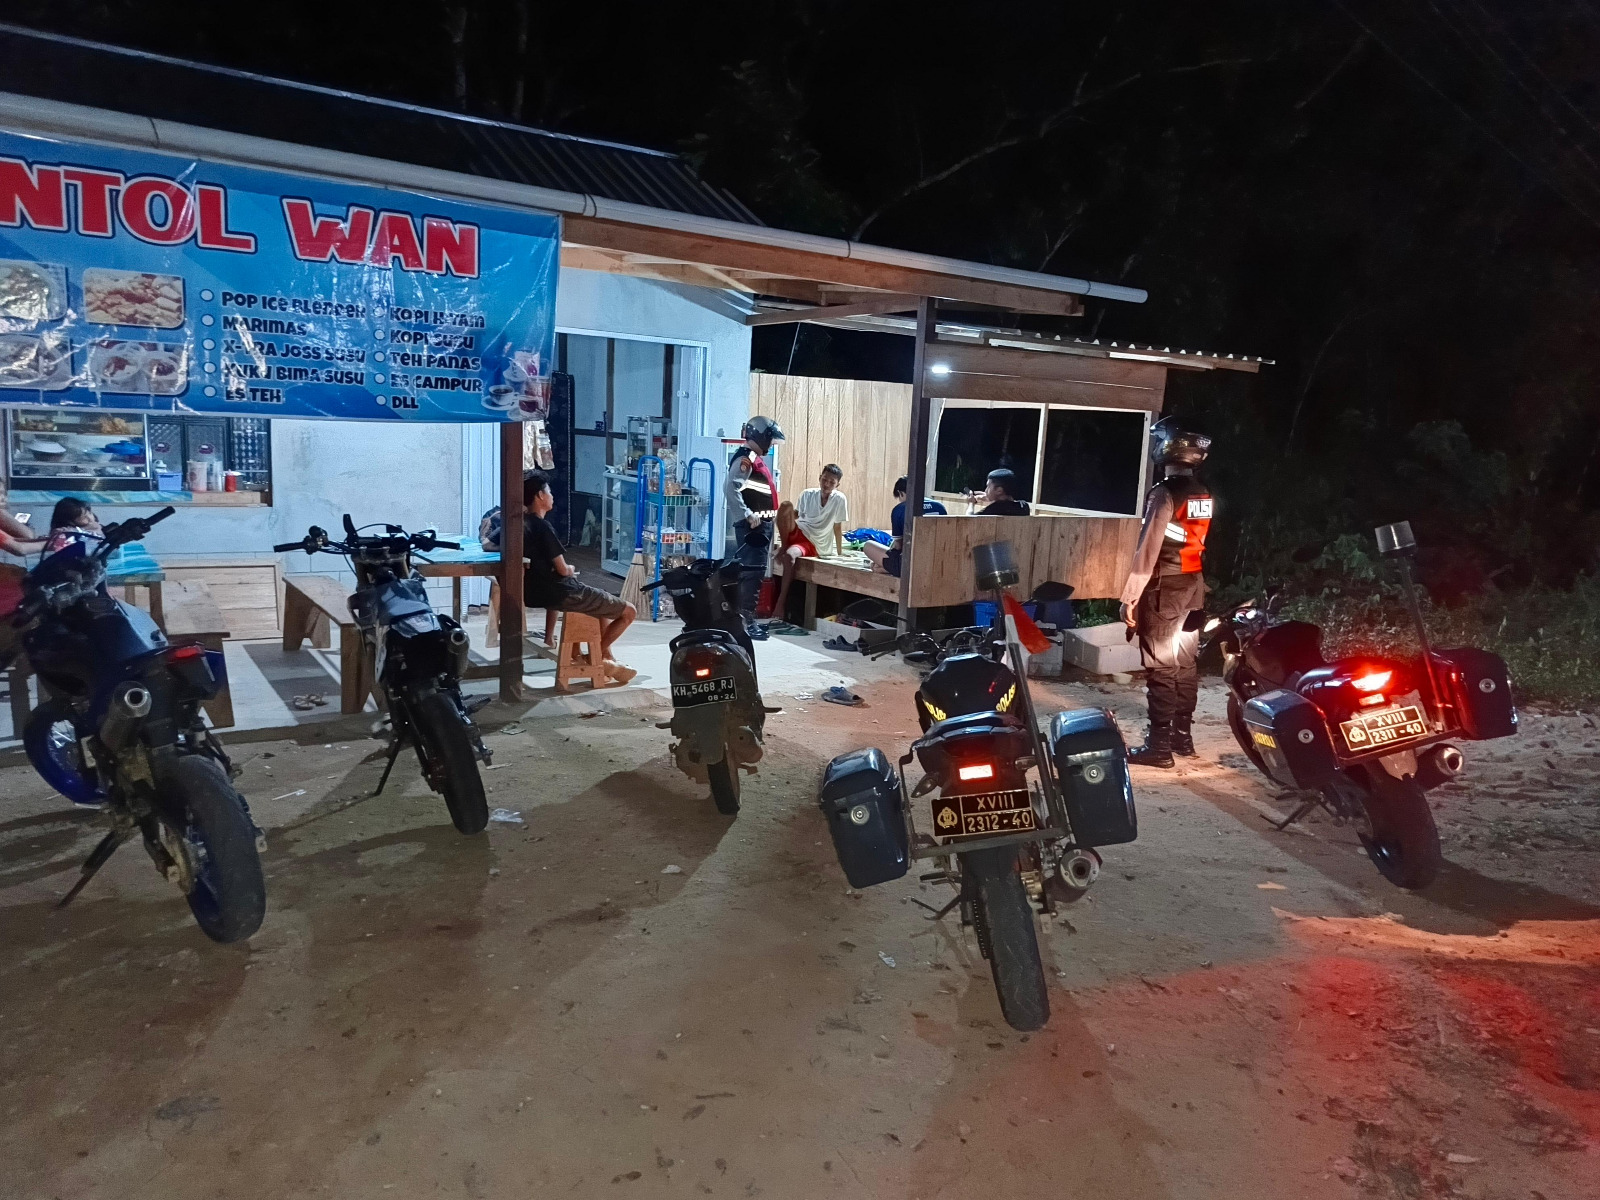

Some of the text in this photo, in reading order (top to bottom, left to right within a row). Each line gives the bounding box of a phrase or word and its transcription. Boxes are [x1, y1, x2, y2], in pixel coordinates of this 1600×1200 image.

[282, 198, 478, 278] WAN
[222, 292, 258, 308] POP
[391, 307, 429, 323] KOPI
[390, 330, 474, 349] KOPI SUSU
[281, 344, 322, 360] JOSS
[325, 347, 366, 363] SUSU
[324, 369, 365, 385] SUSU
[391, 373, 409, 388] ES
[225, 388, 281, 403] ES TEH
[392, 396, 419, 409] DLL
[673, 679, 733, 696] KH 5468 RJ
[1375, 712, 1407, 727] XVIII
[1372, 723, 1422, 742] 2311-40
[976, 794, 1015, 811] XVIII
[967, 811, 1030, 832] 2312-40
